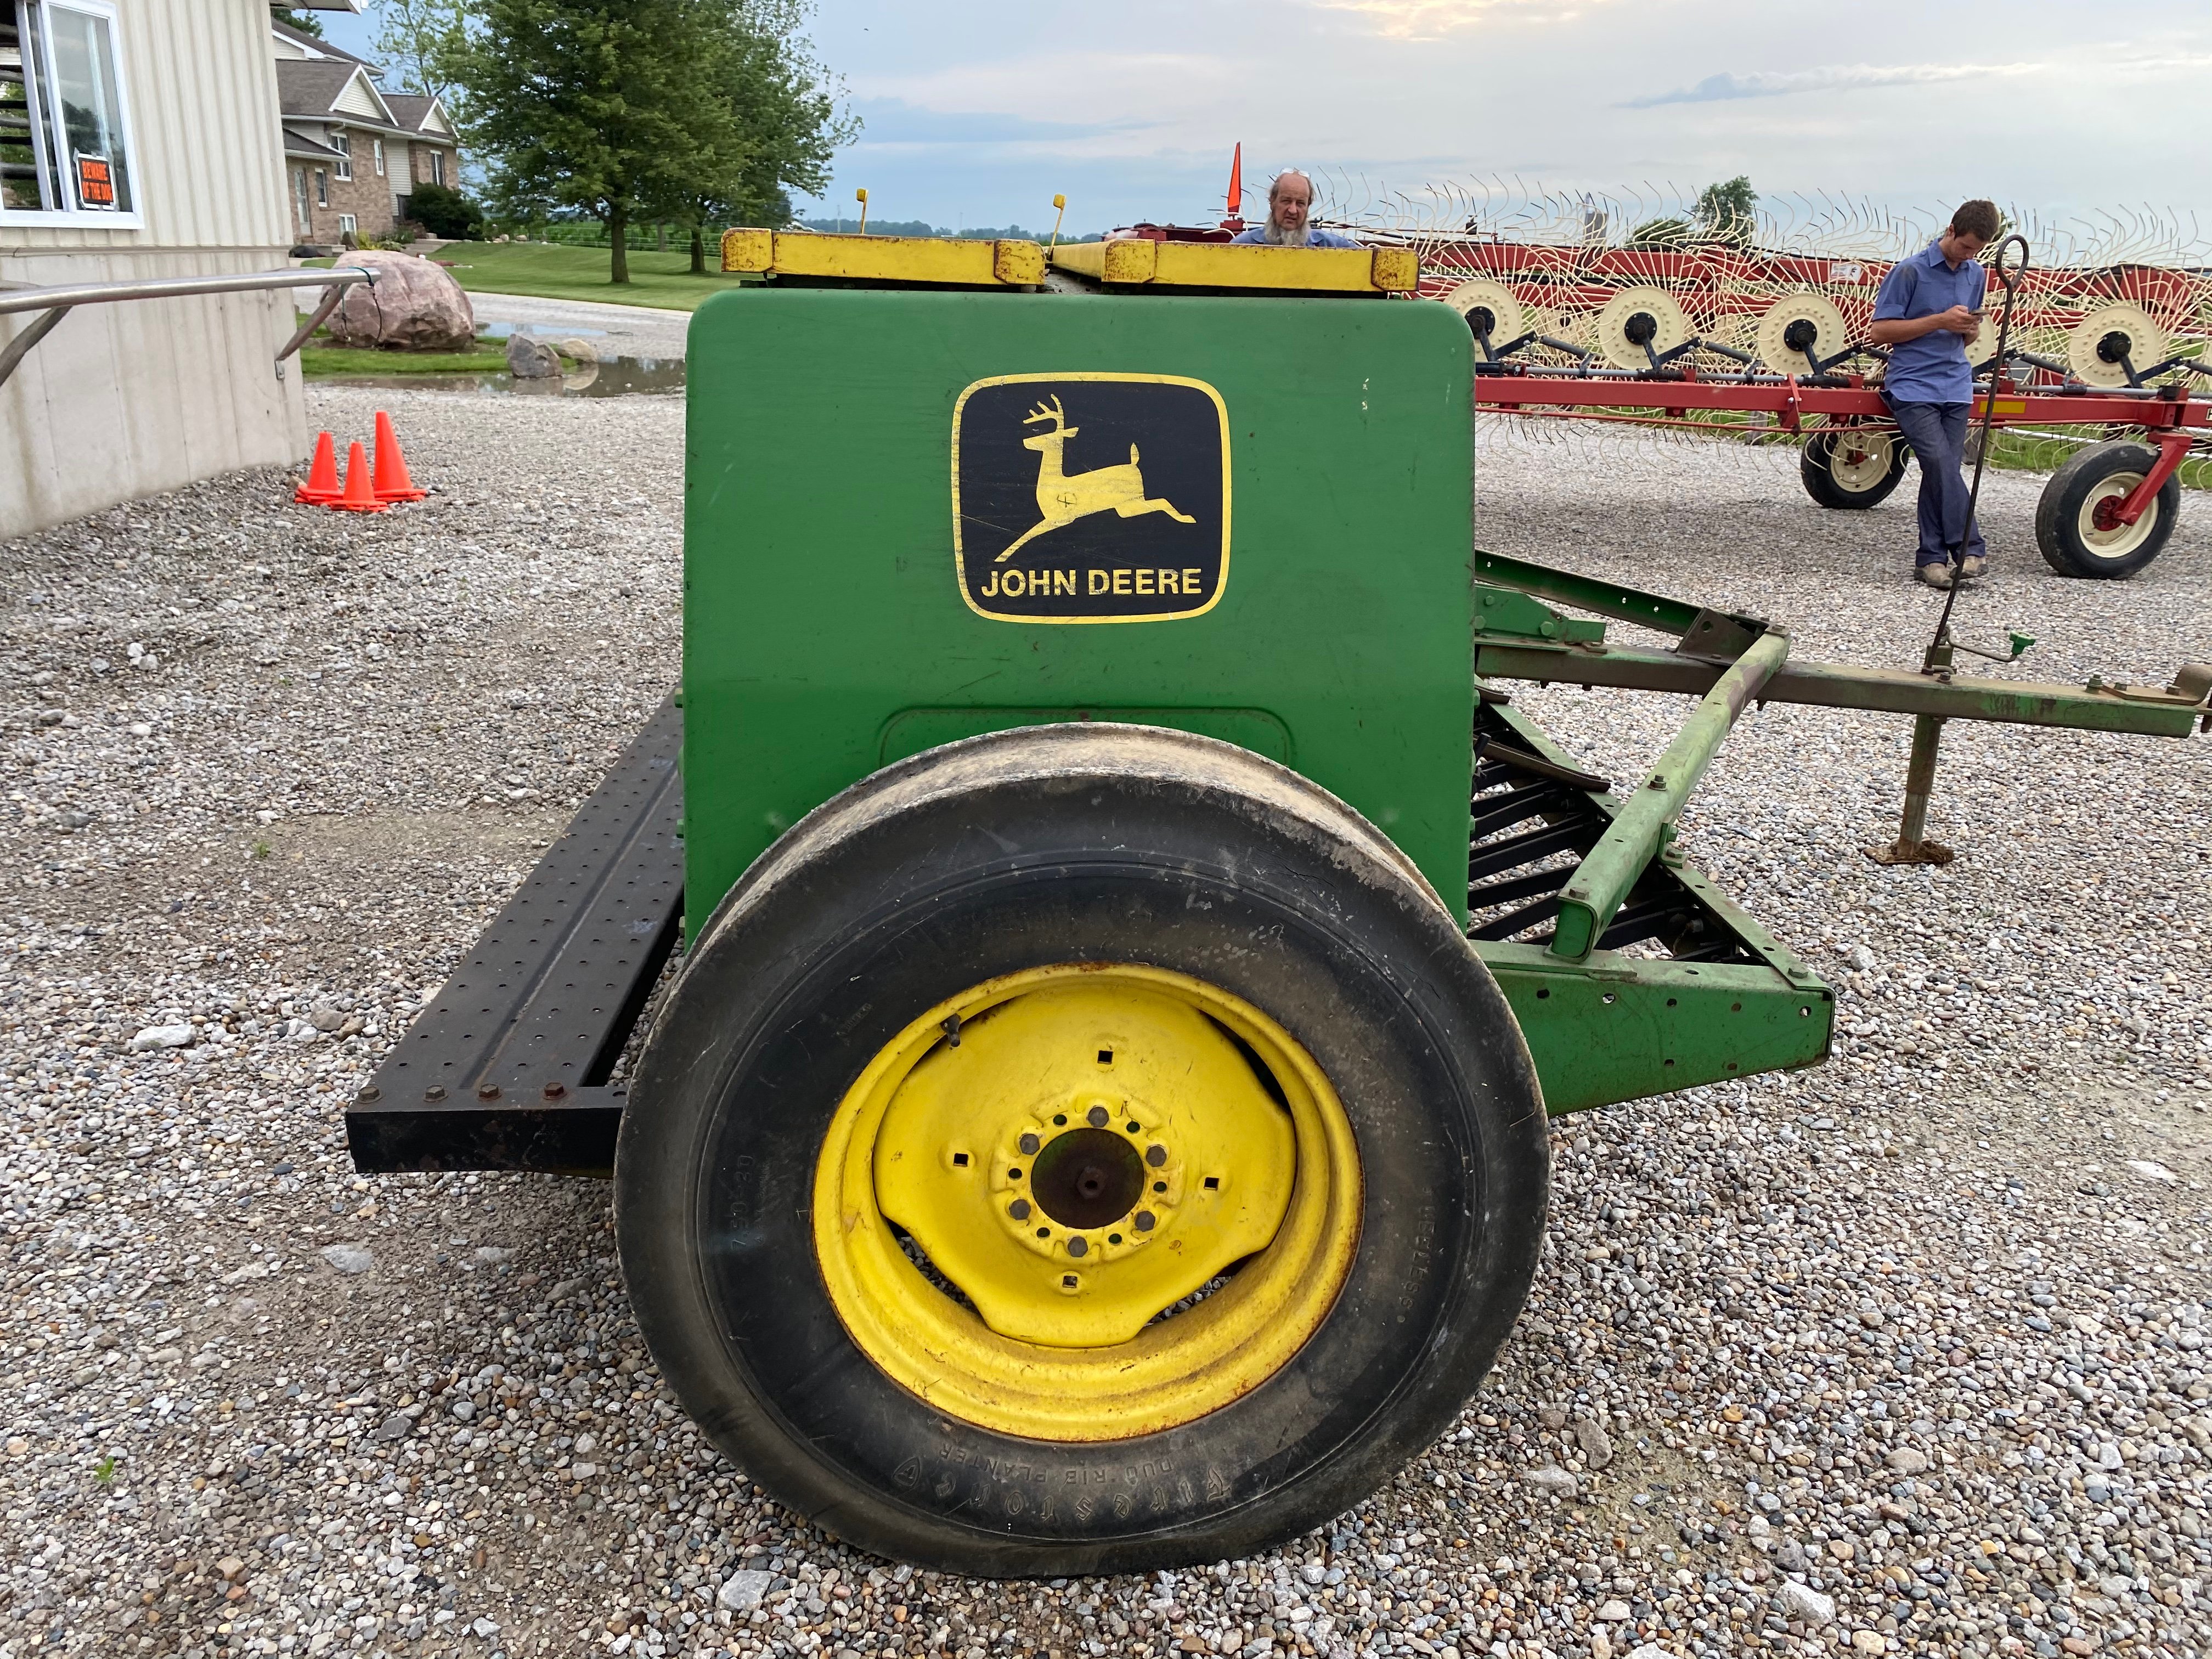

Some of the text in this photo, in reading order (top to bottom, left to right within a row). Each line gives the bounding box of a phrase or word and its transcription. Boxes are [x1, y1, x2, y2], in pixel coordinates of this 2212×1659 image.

[981, 568, 1202, 597] JOHN DEERE
[939, 1443, 1049, 1482] PLANTER
[1066, 1469, 1106, 1485] RIB
[936, 1465, 1231, 1521] Firestone
